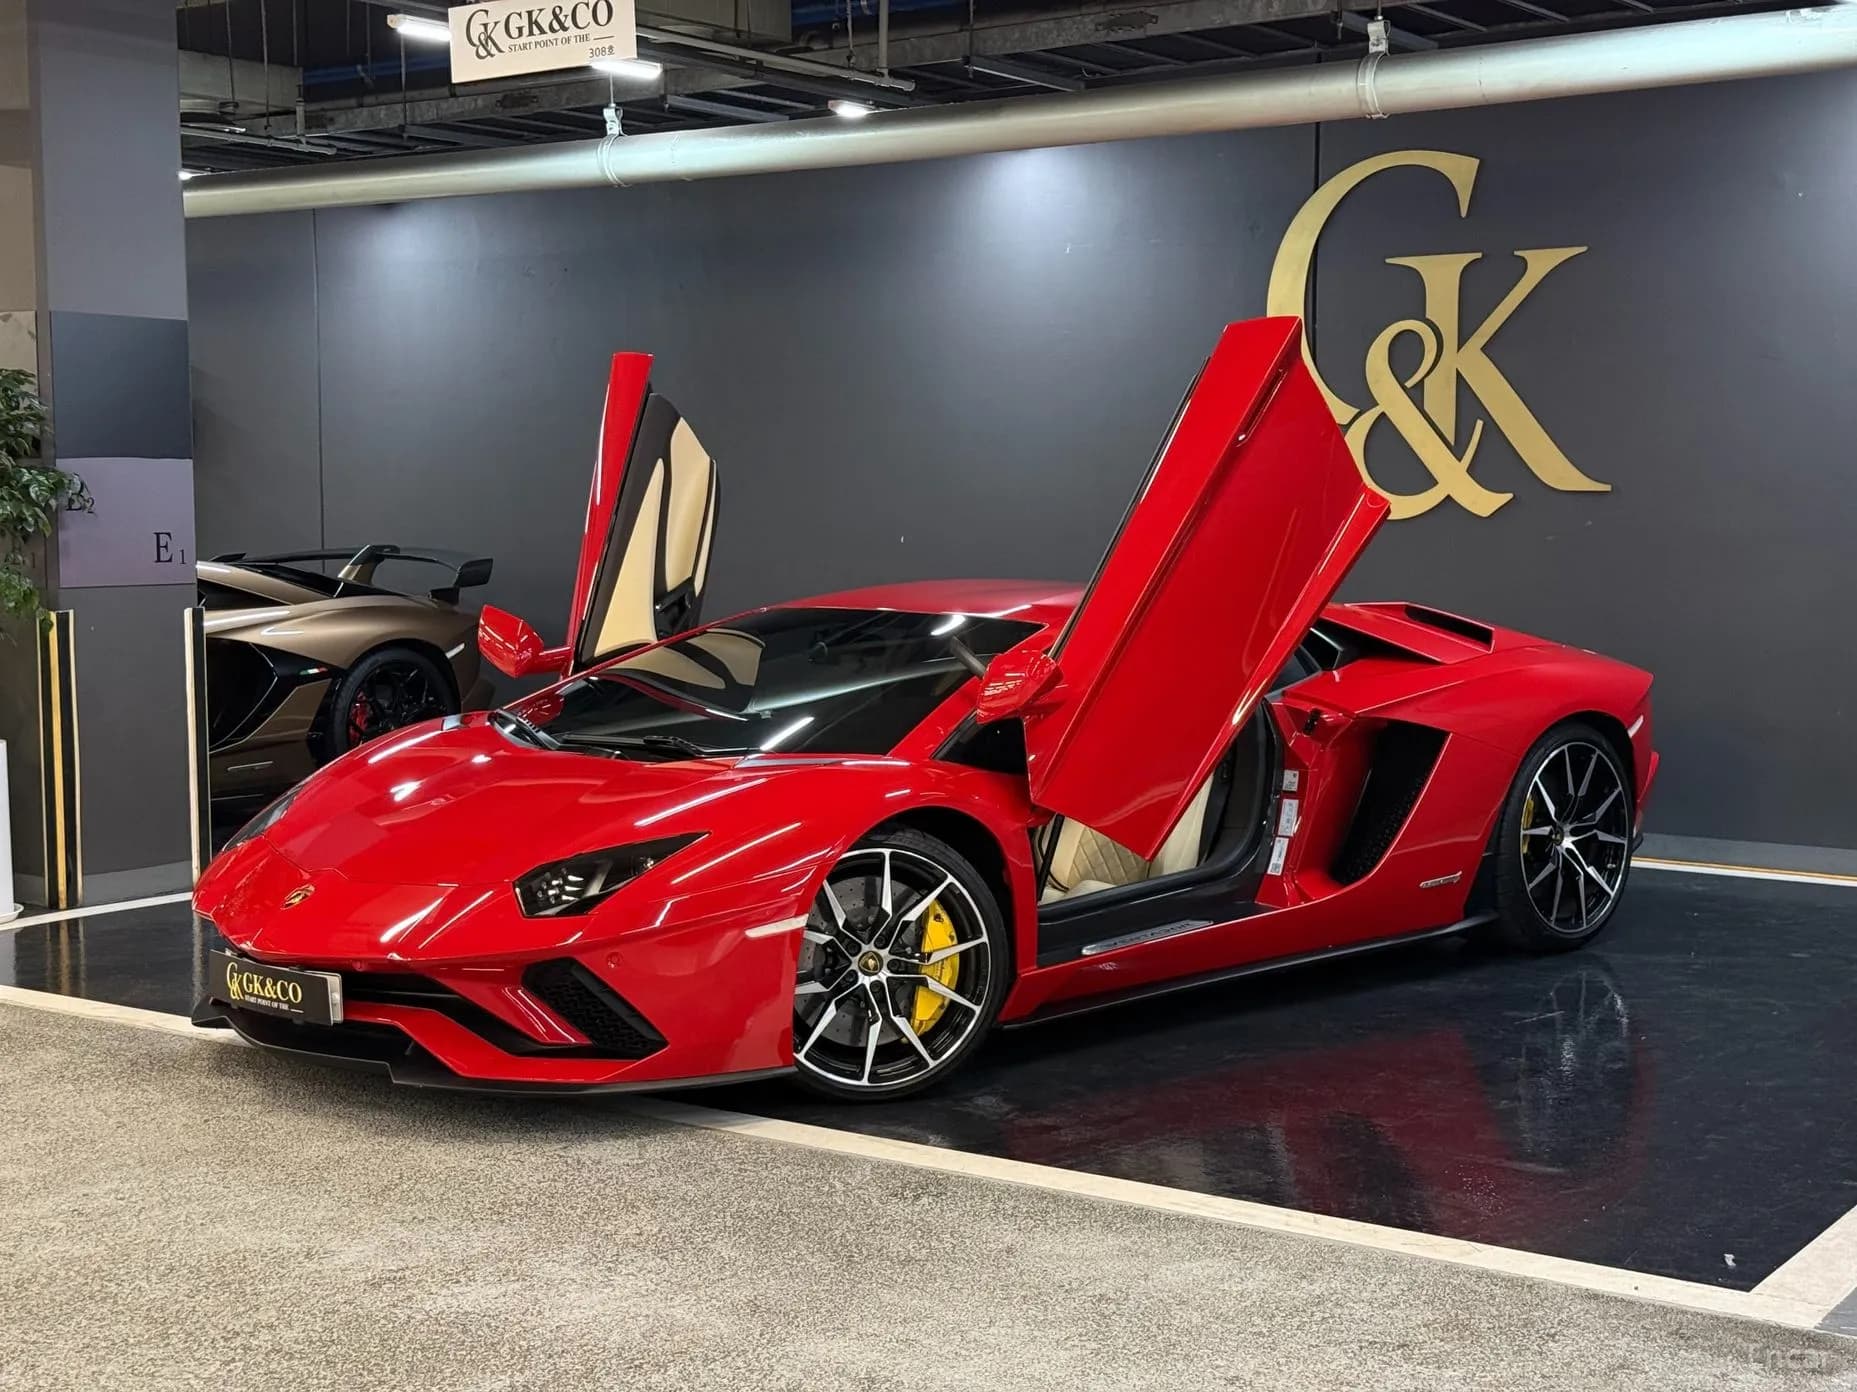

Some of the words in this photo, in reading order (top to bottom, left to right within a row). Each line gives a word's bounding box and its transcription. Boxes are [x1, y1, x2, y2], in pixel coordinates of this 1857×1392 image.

[504, 0, 614, 40] GK&CO
[508, 42, 533, 53] START
[534, 38, 559, 49] POINT
[561, 36, 573, 45] OF
[574, 33, 591, 44] THE
[243, 972, 303, 1004] GK&CO
